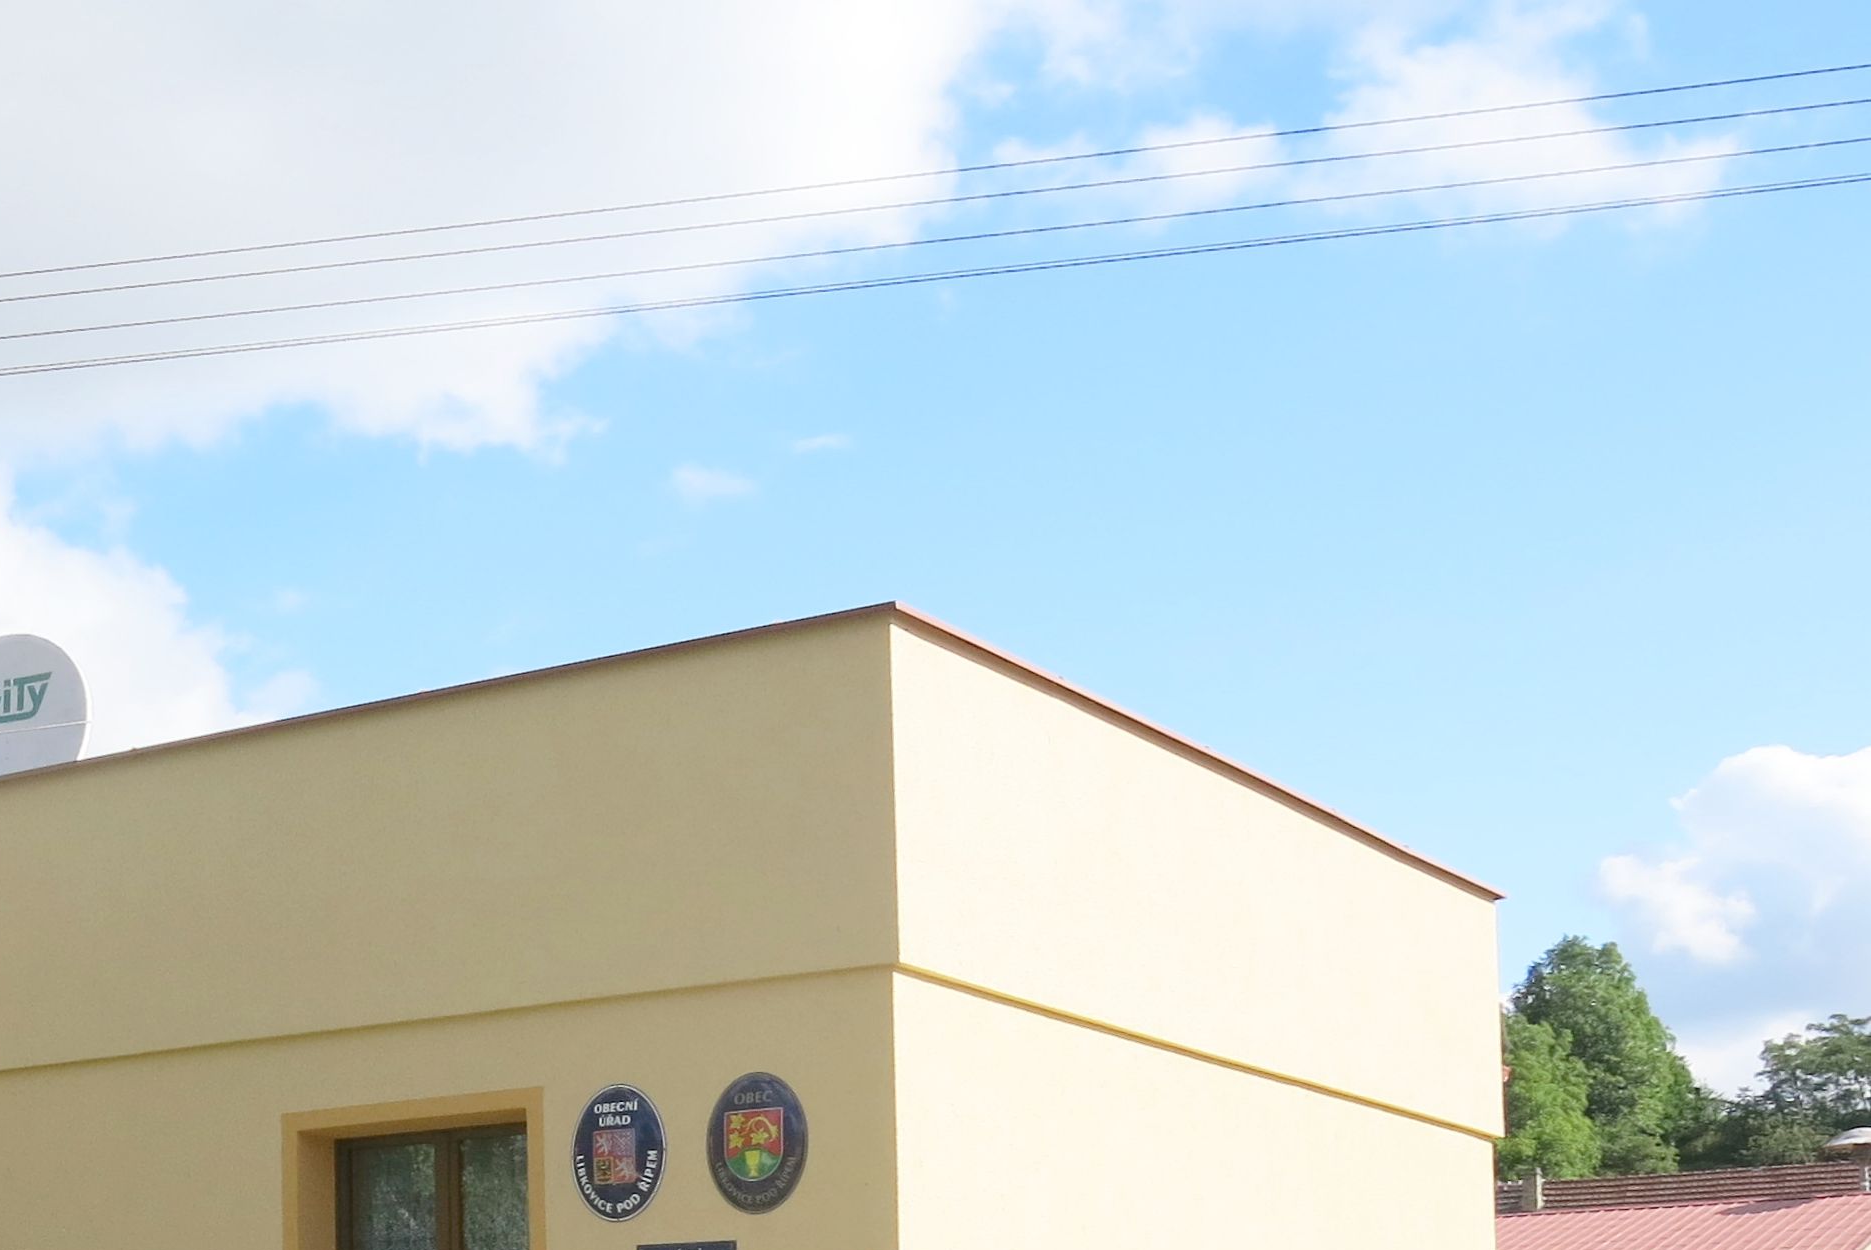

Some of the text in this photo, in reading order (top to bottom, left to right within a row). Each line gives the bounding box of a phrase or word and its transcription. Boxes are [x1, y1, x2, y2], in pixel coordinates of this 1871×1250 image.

[733, 1090, 773, 1105] OBEC
[593, 1098, 639, 1114] OBECNÍ
[598, 1114, 632, 1127] ÚŘAD
[575, 1154, 614, 1213] LIBKOVICE
[616, 1193, 641, 1213] POD
[715, 1161, 754, 1204] LIBKOVICE
[755, 1187, 779, 1204] POD
